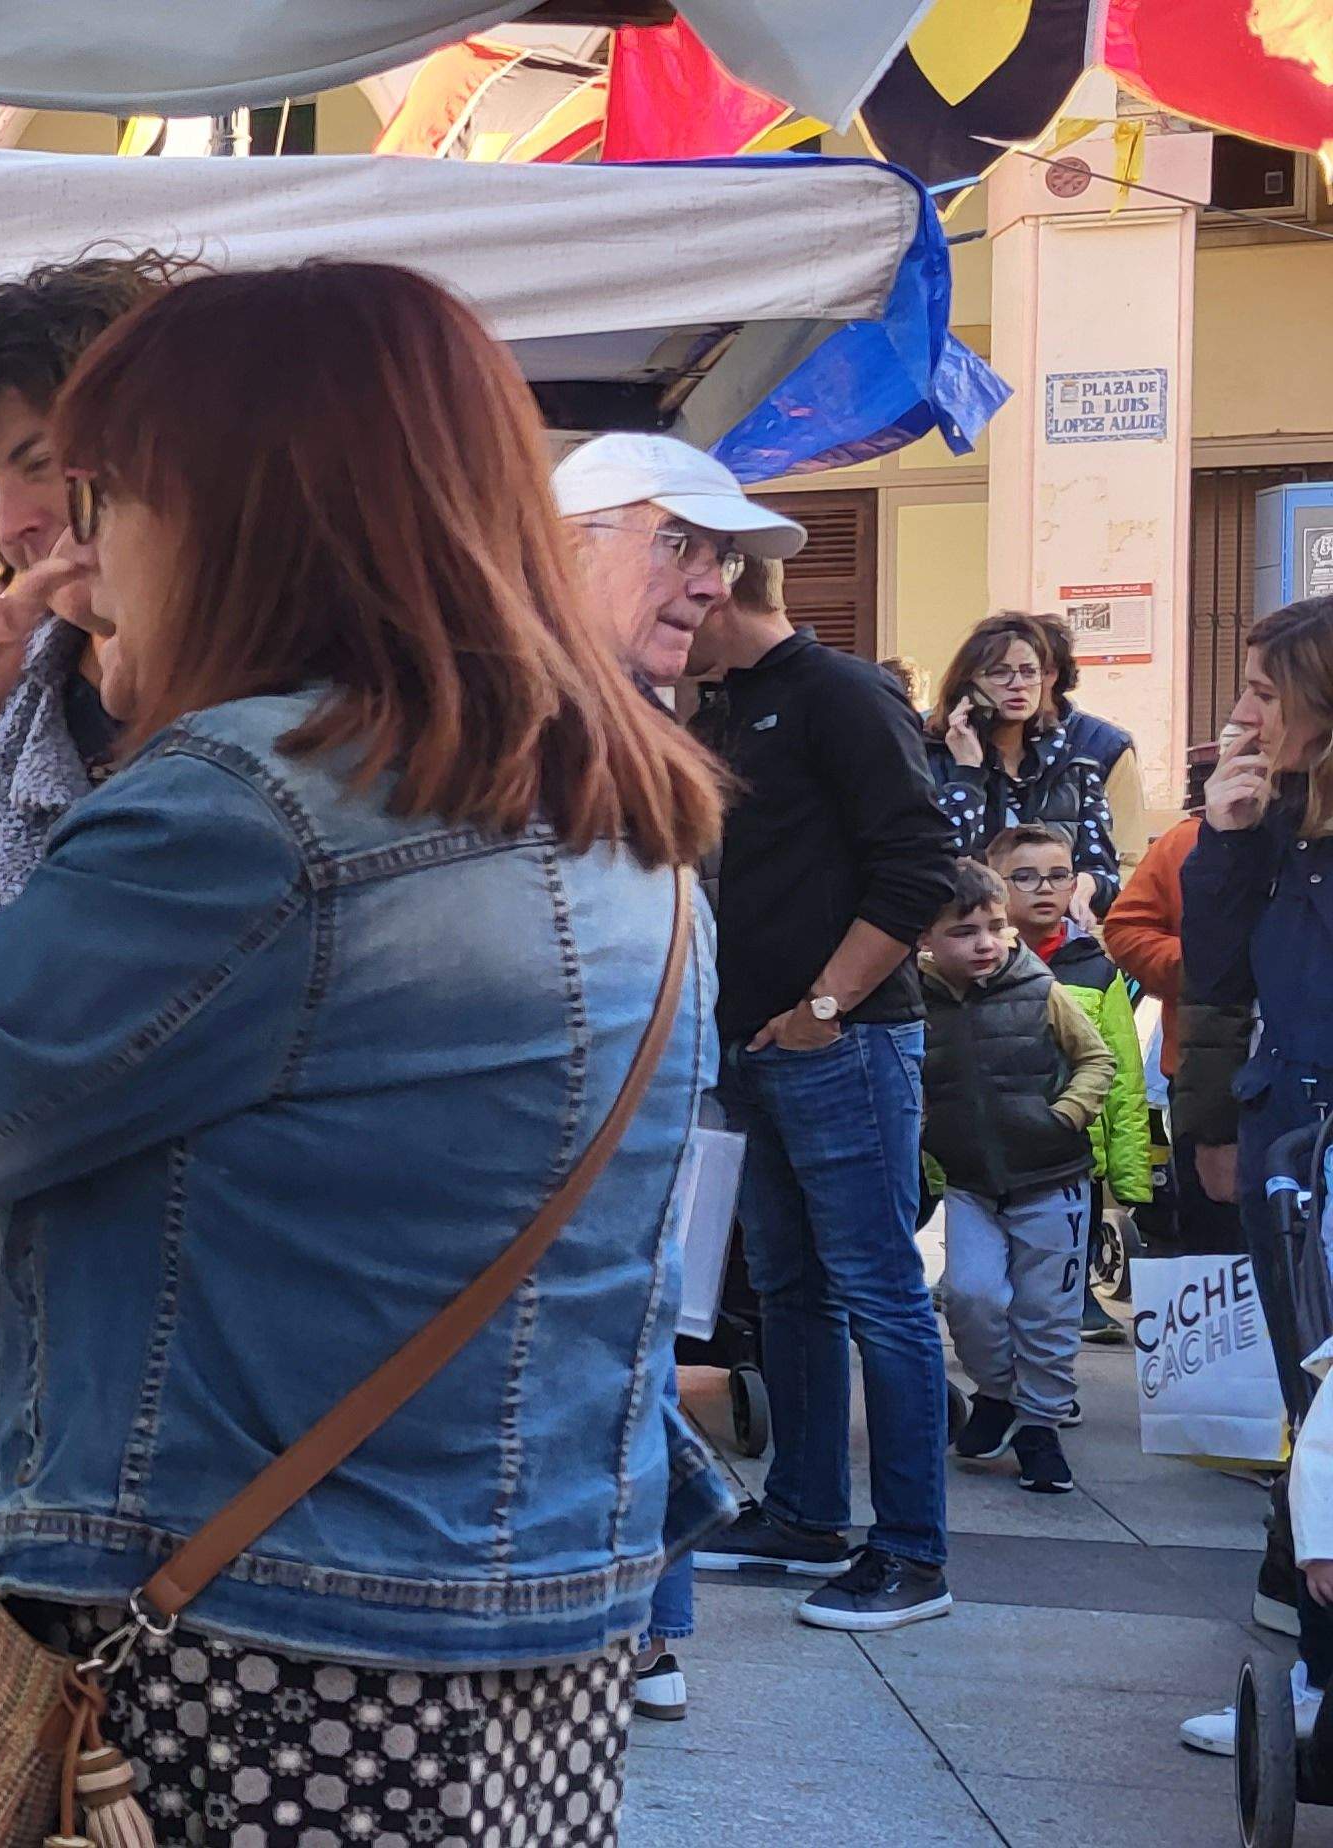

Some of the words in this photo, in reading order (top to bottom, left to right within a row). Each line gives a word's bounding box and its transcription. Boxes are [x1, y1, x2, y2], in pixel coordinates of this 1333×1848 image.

[1081, 381, 1134, 396] PLAZA
[1139, 381, 1157, 394] DE
[1104, 397, 1150, 414] LUIS
[1054, 416, 1105, 433] LOPEZ
[1134, 1256, 1254, 1353] CACHE
[1141, 1301, 1259, 1399] CACHE
